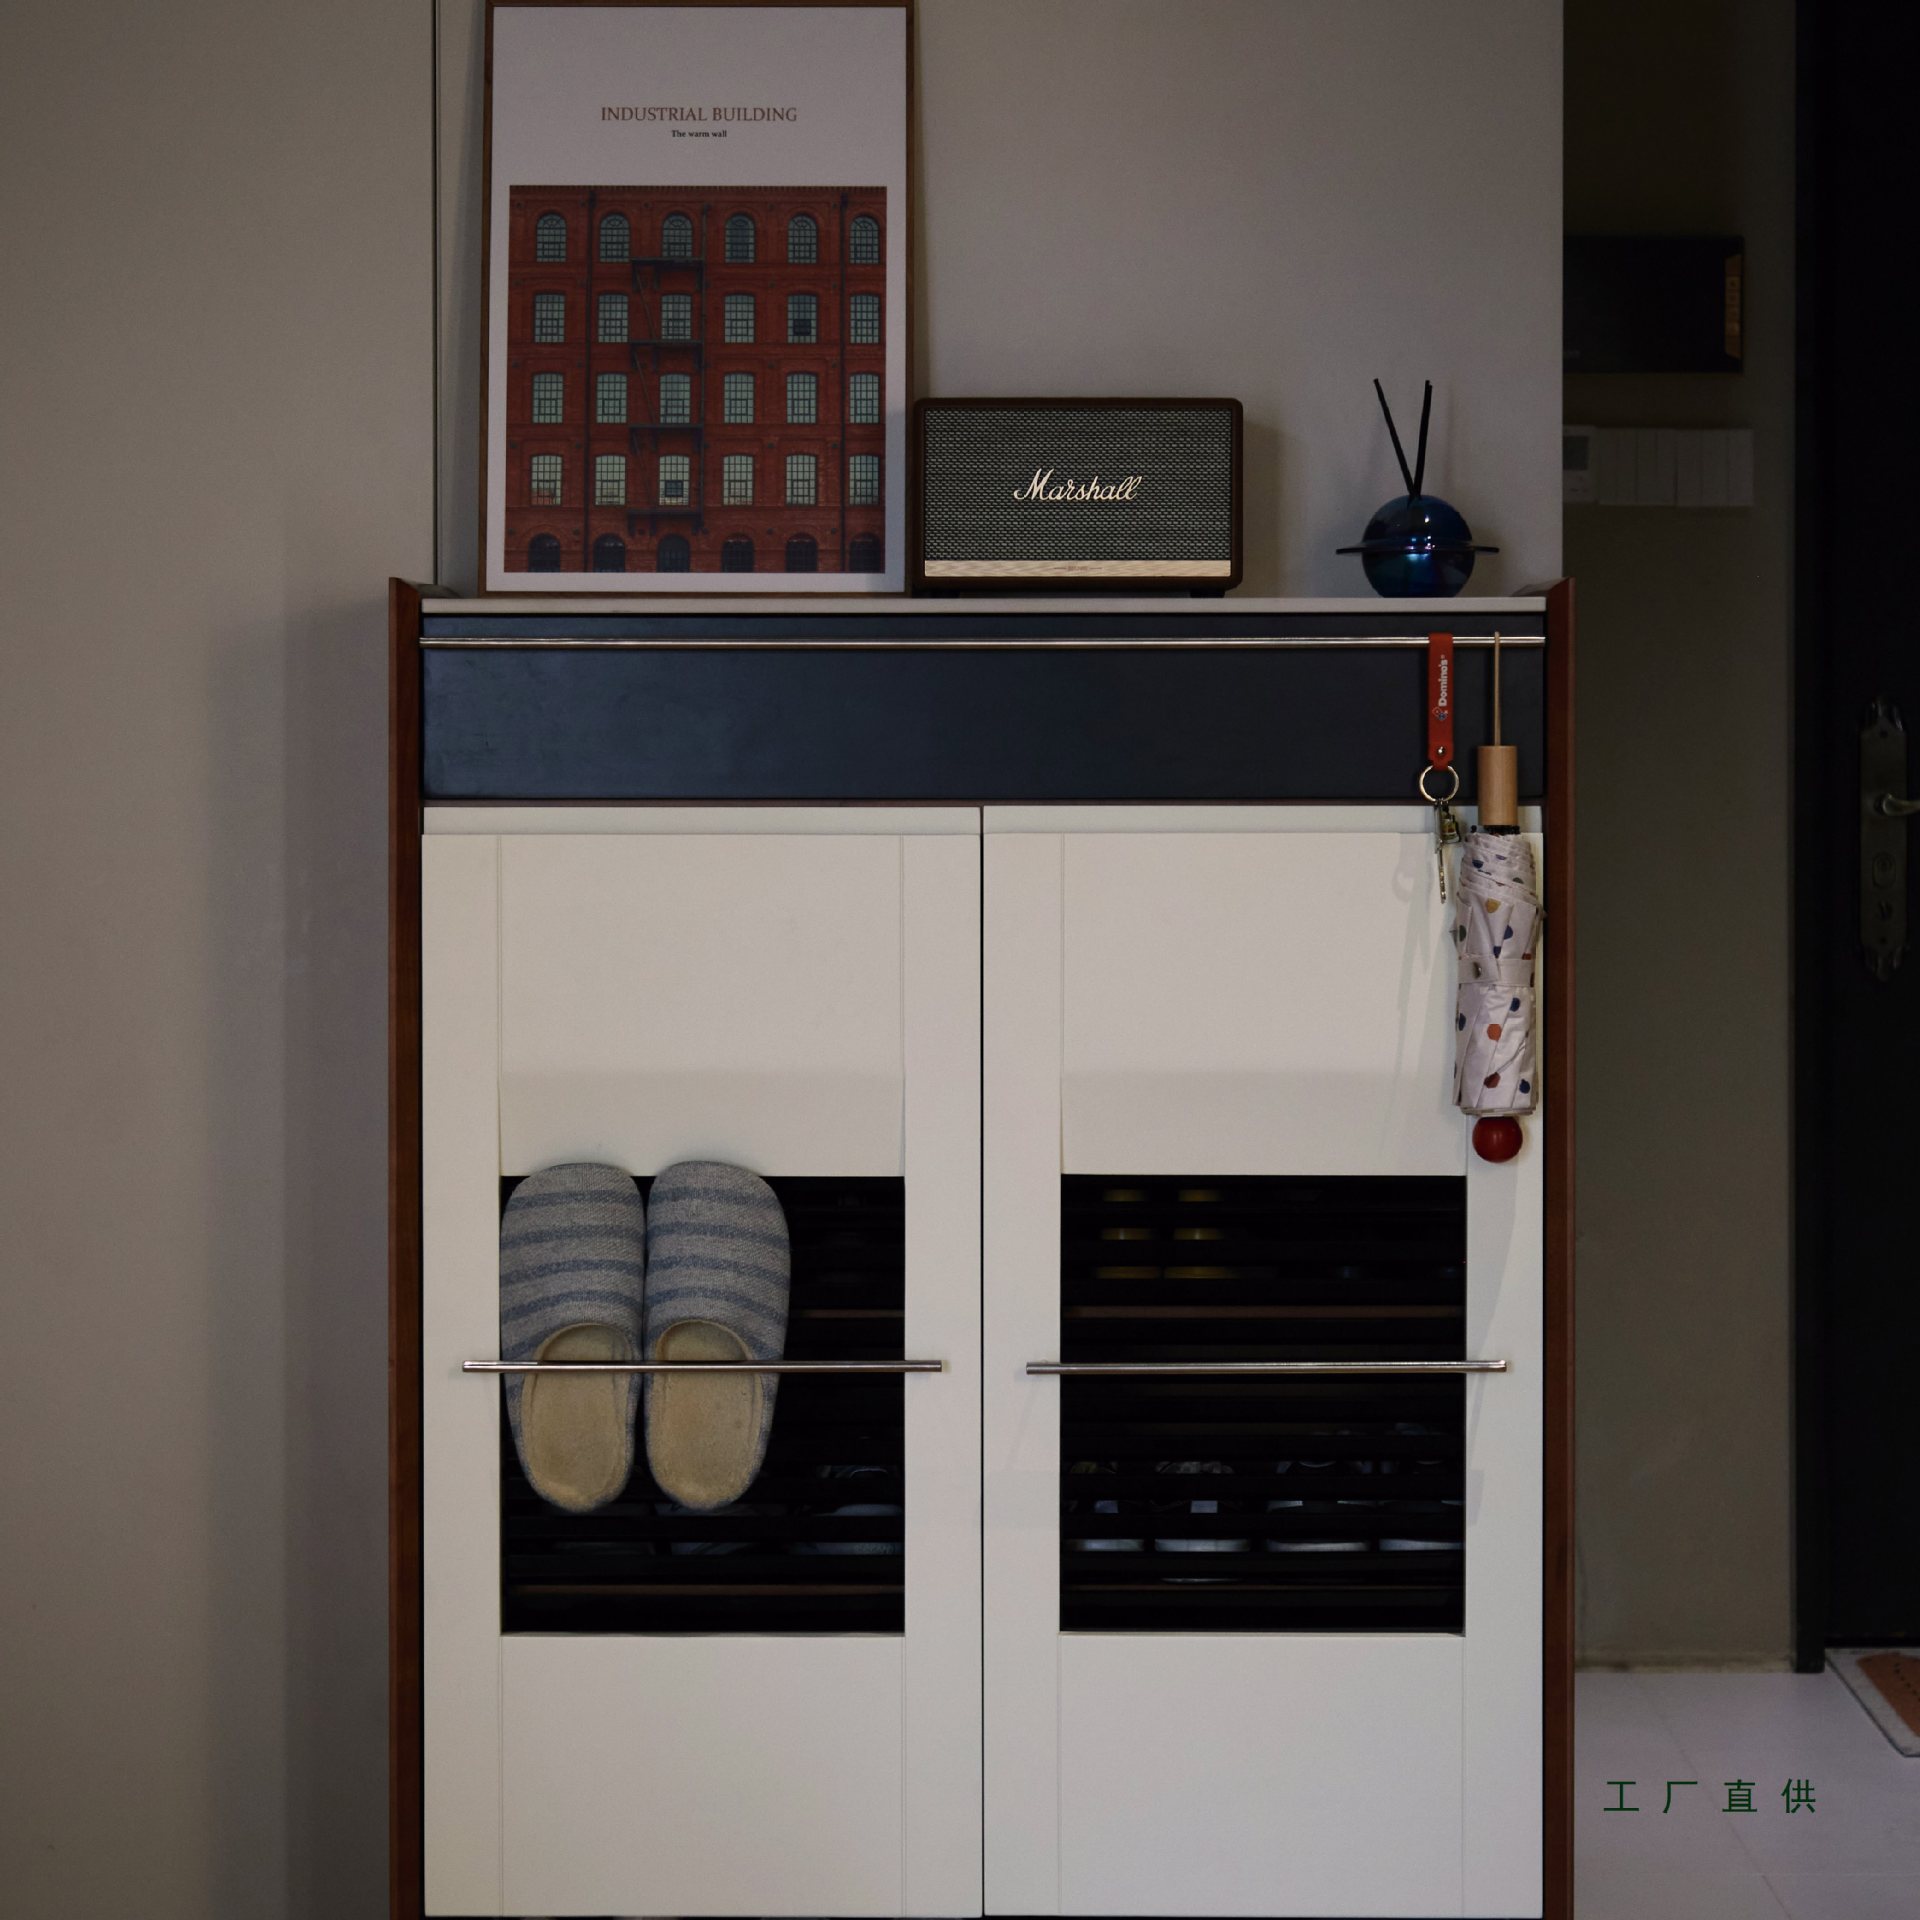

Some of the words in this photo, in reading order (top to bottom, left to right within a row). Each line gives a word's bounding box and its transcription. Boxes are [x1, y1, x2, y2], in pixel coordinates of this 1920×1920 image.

[601, 107, 707, 121] INDUSTRIAL
[712, 107, 798, 121] BUILDING
[671, 130, 686, 138] The
[711, 130, 727, 138] wall
[1013, 468, 1142, 500] Marshall
[1438, 658, 1448, 707] Domino's
